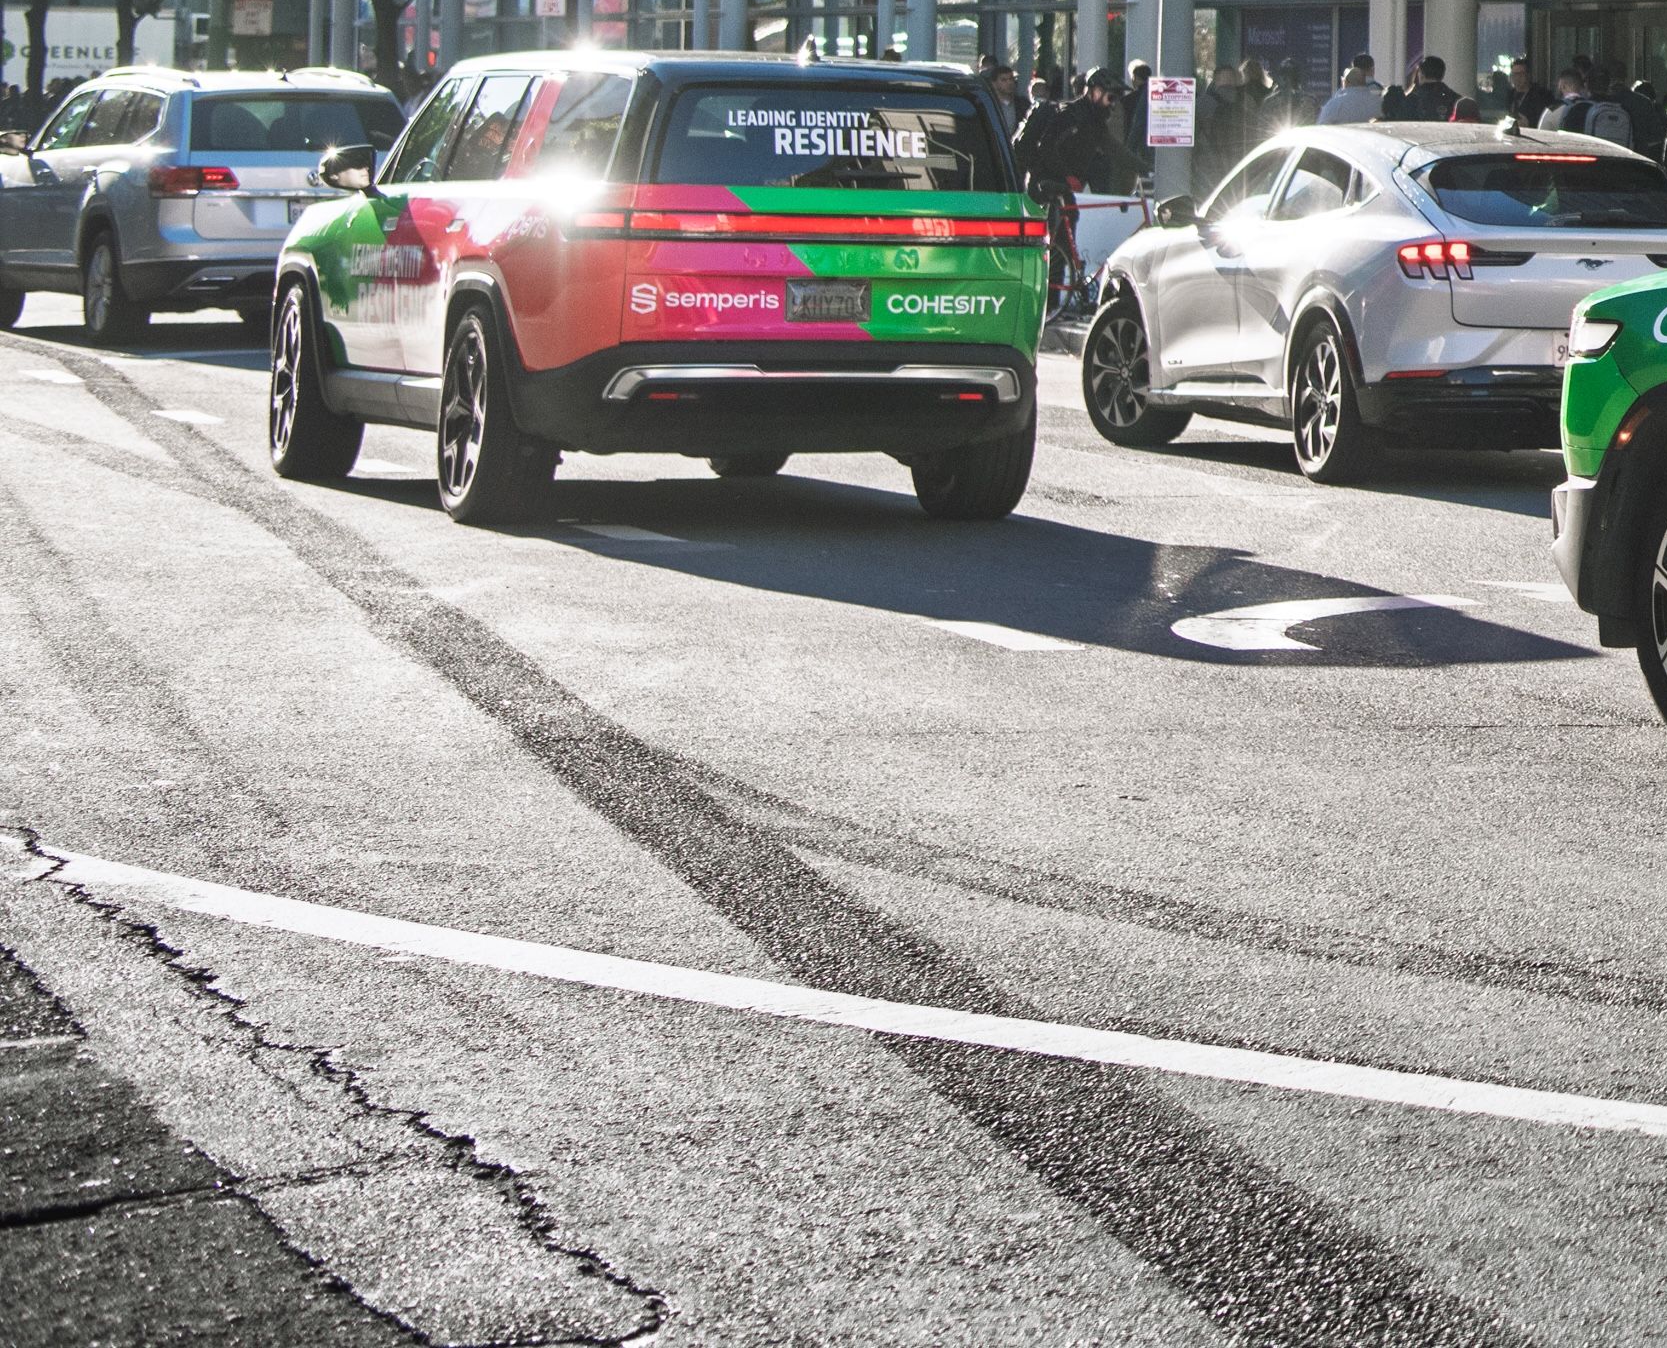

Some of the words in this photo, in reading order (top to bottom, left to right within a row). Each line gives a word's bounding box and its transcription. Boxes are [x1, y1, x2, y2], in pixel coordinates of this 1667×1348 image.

[728, 110, 797, 127] LEADING
[800, 110, 870, 128] IDENTITY
[774, 128, 927, 158] RESILIENCE
[664, 290, 780, 314] semperis
[887, 295, 1007, 316] COHESITY
